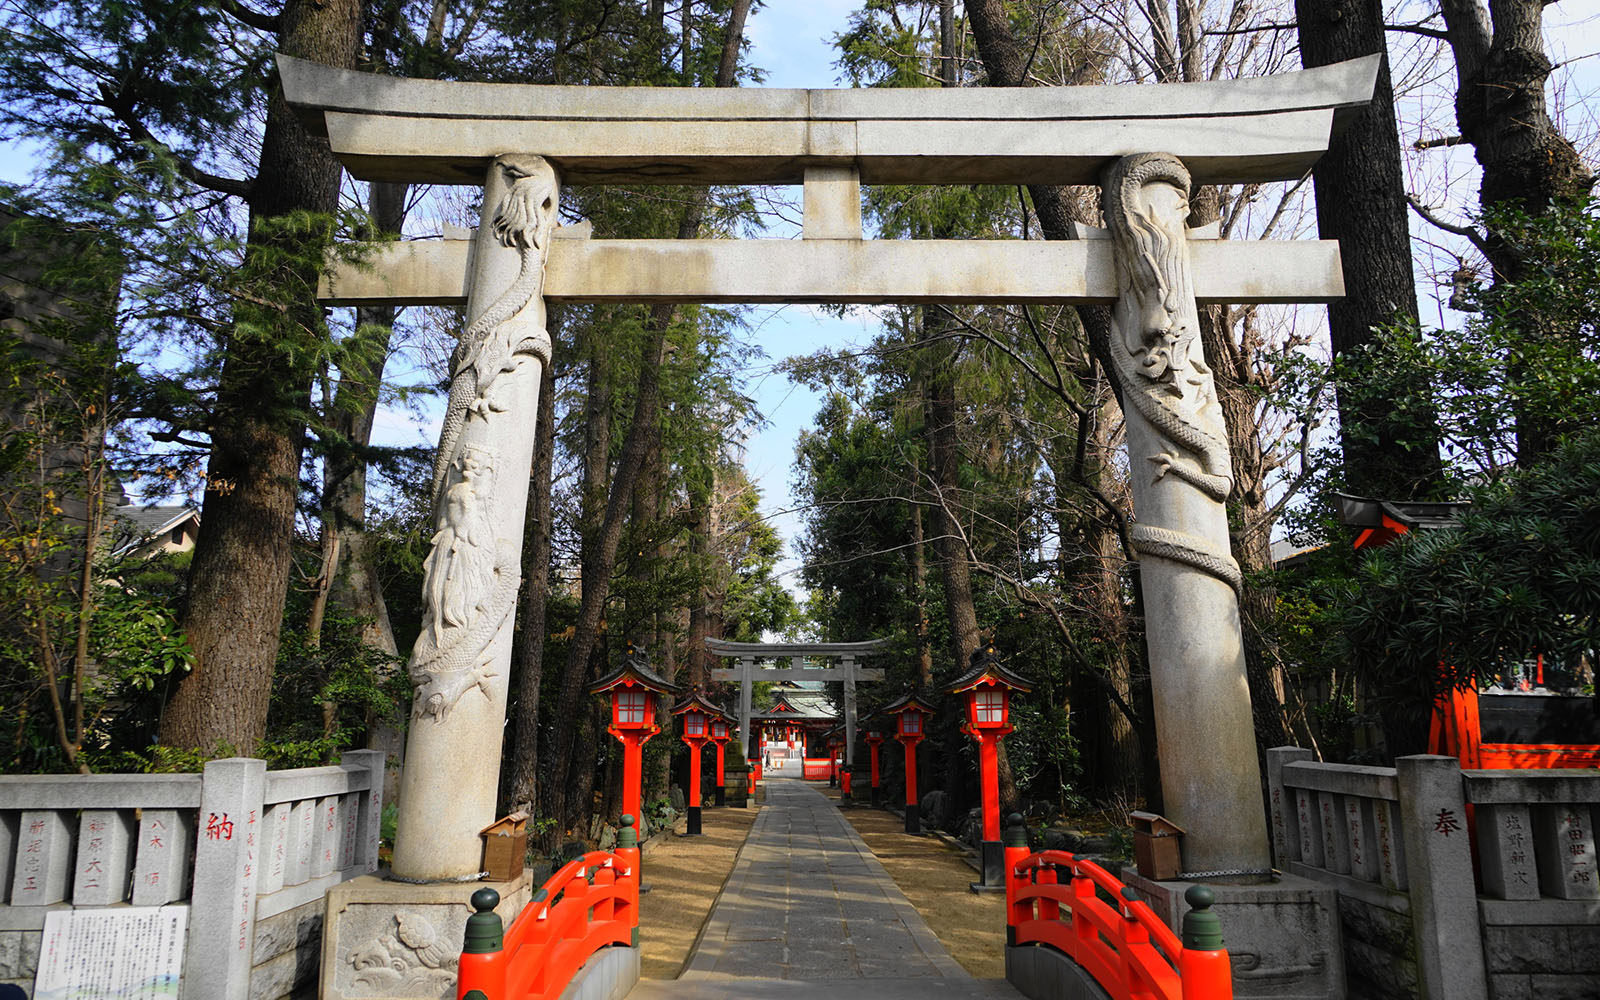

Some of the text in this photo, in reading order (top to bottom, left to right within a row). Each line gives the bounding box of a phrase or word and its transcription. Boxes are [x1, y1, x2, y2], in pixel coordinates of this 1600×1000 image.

[206, 812, 233, 840] 納
[1434, 808, 1461, 837] 奉
[1565, 814, 1589, 883] 村田昭一郎
